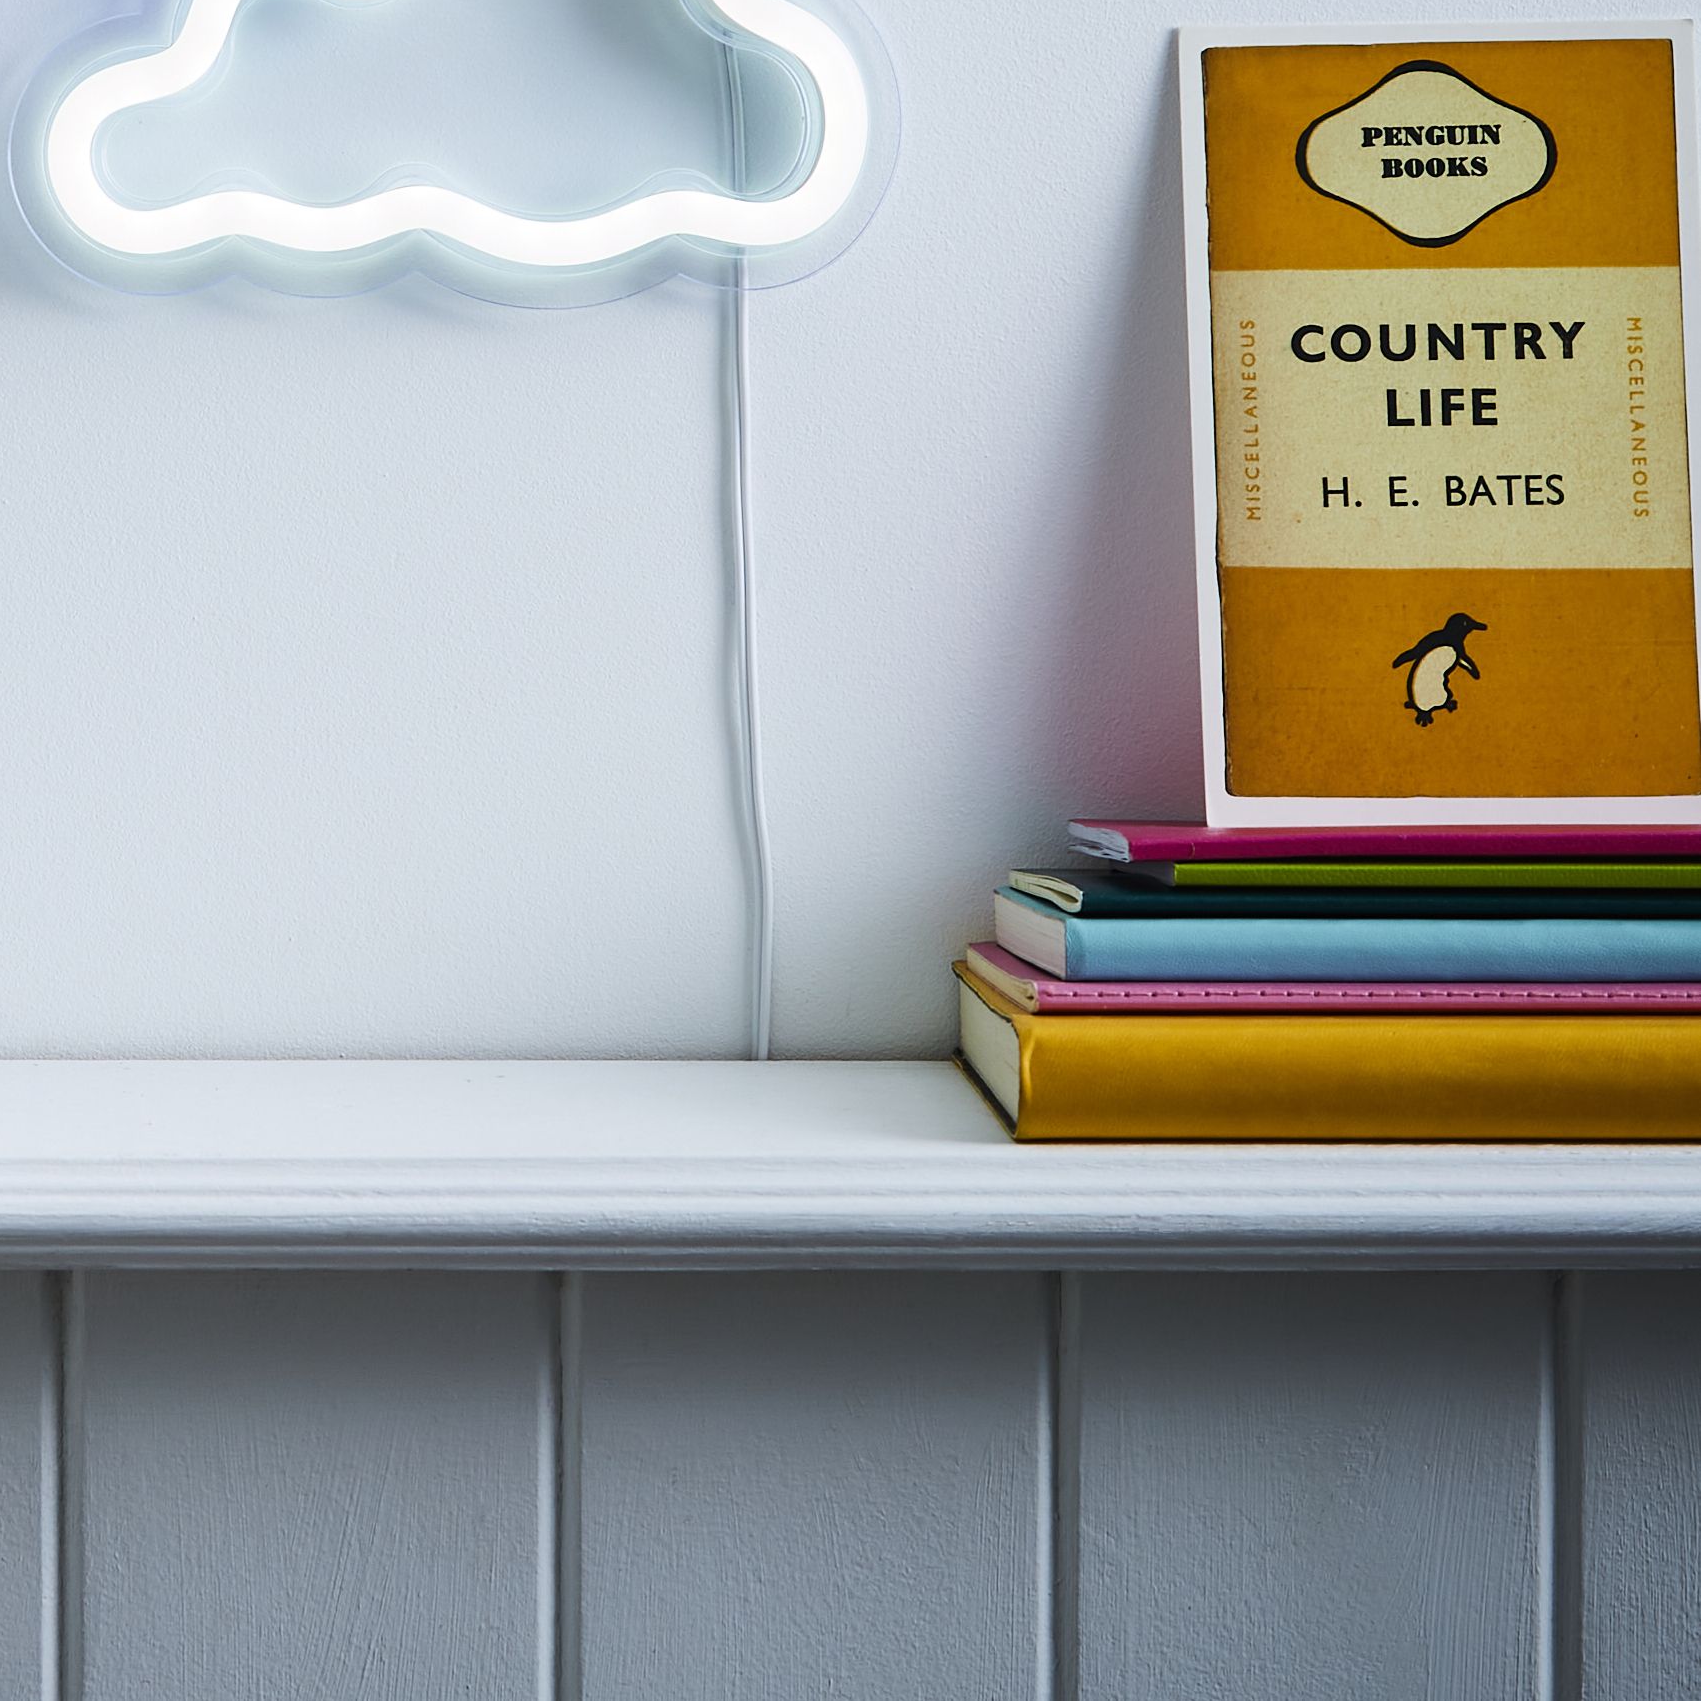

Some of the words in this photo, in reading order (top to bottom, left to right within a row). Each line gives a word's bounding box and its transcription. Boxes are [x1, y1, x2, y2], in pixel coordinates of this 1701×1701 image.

[1360, 123, 1502, 148] PENGUIN
[1380, 156, 1489, 179] BOOKS
[1290, 321, 1586, 363] COUNTRY
[1238, 318, 1262, 521] MISCELLANEOUS
[1385, 387, 1499, 428] LIFE
[1626, 317, 1650, 519] MISCELLANEOUS
[1321, 475, 1363, 508] H.
[1388, 475, 1420, 508] E.
[1444, 473, 1566, 507] BATES
